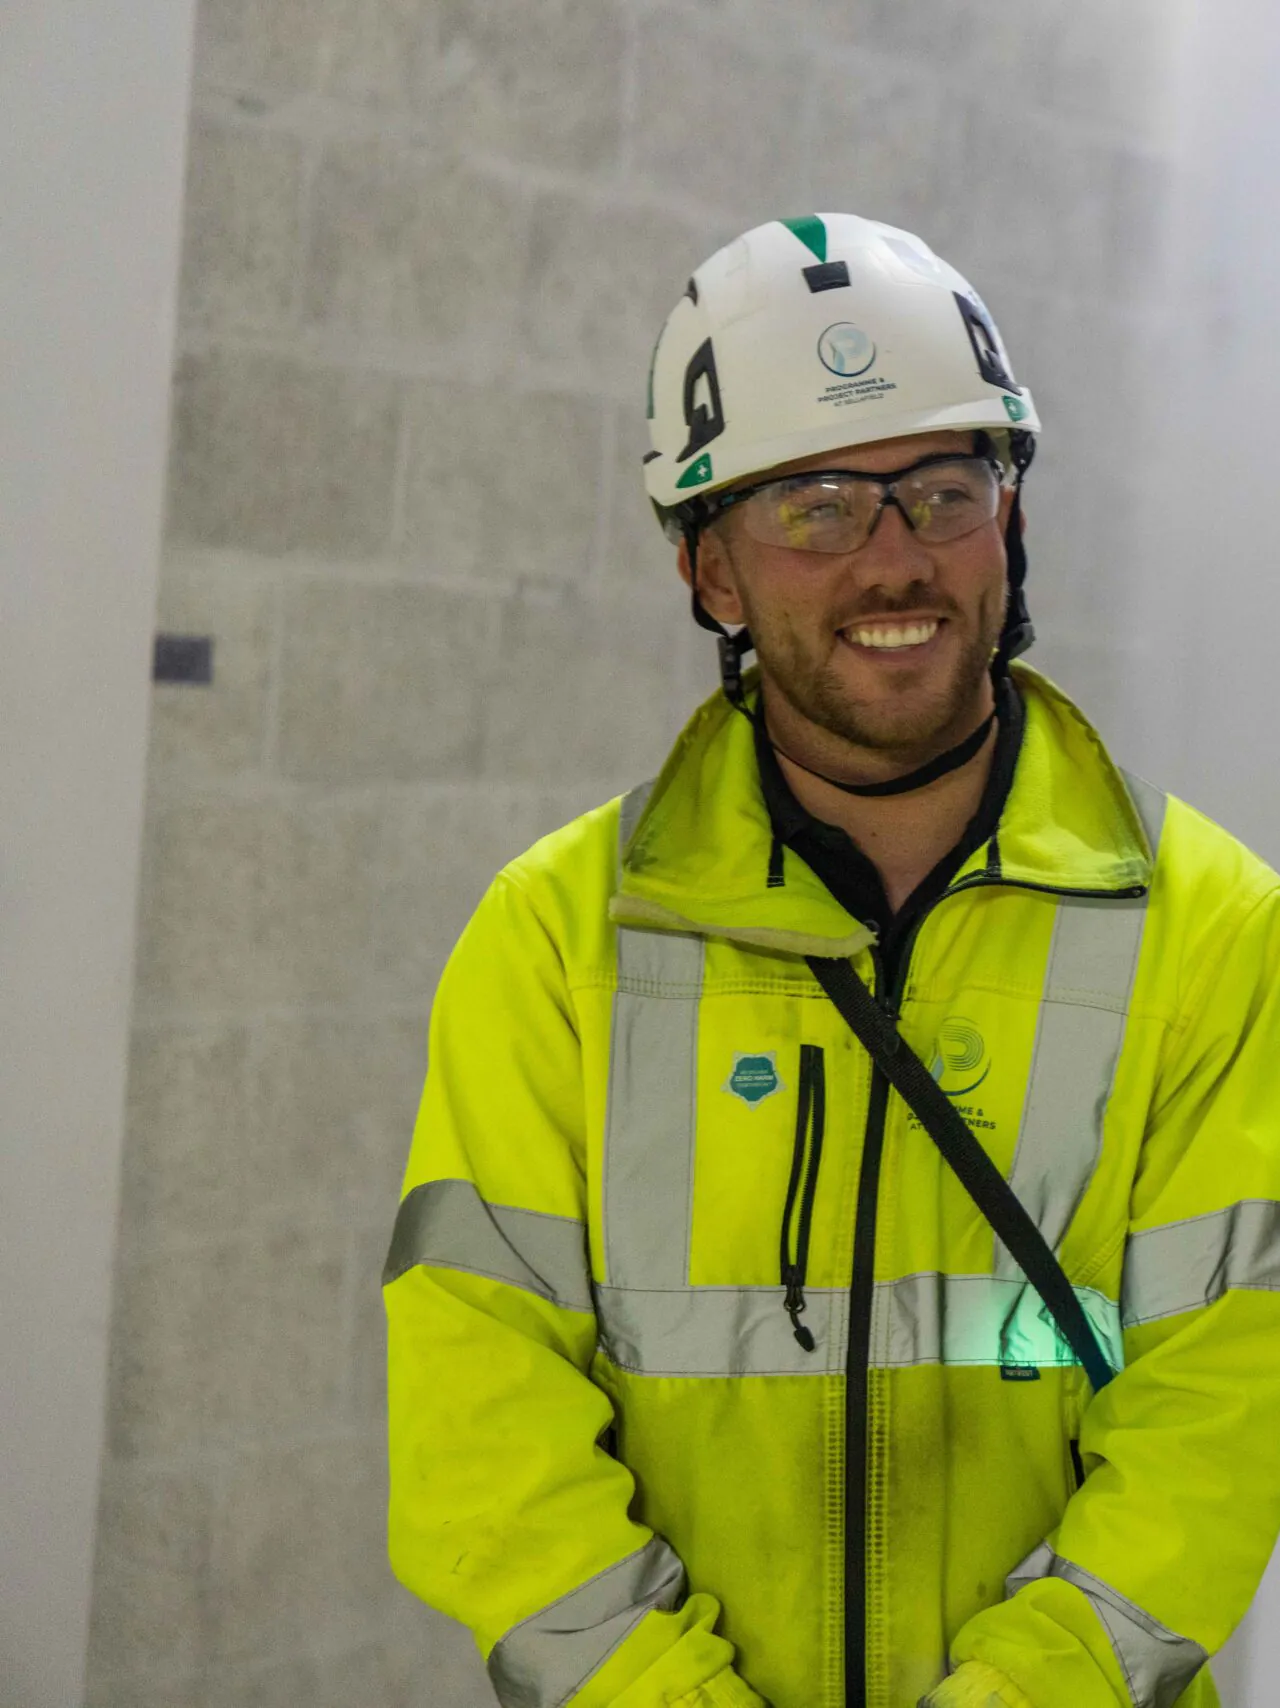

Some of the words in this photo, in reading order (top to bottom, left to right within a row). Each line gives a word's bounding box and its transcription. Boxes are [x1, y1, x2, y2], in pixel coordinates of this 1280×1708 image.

[817, 390, 853, 402] PROJECT
[855, 382, 897, 394] PARTNERS
[824, 378, 877, 392] PROGRAMME
